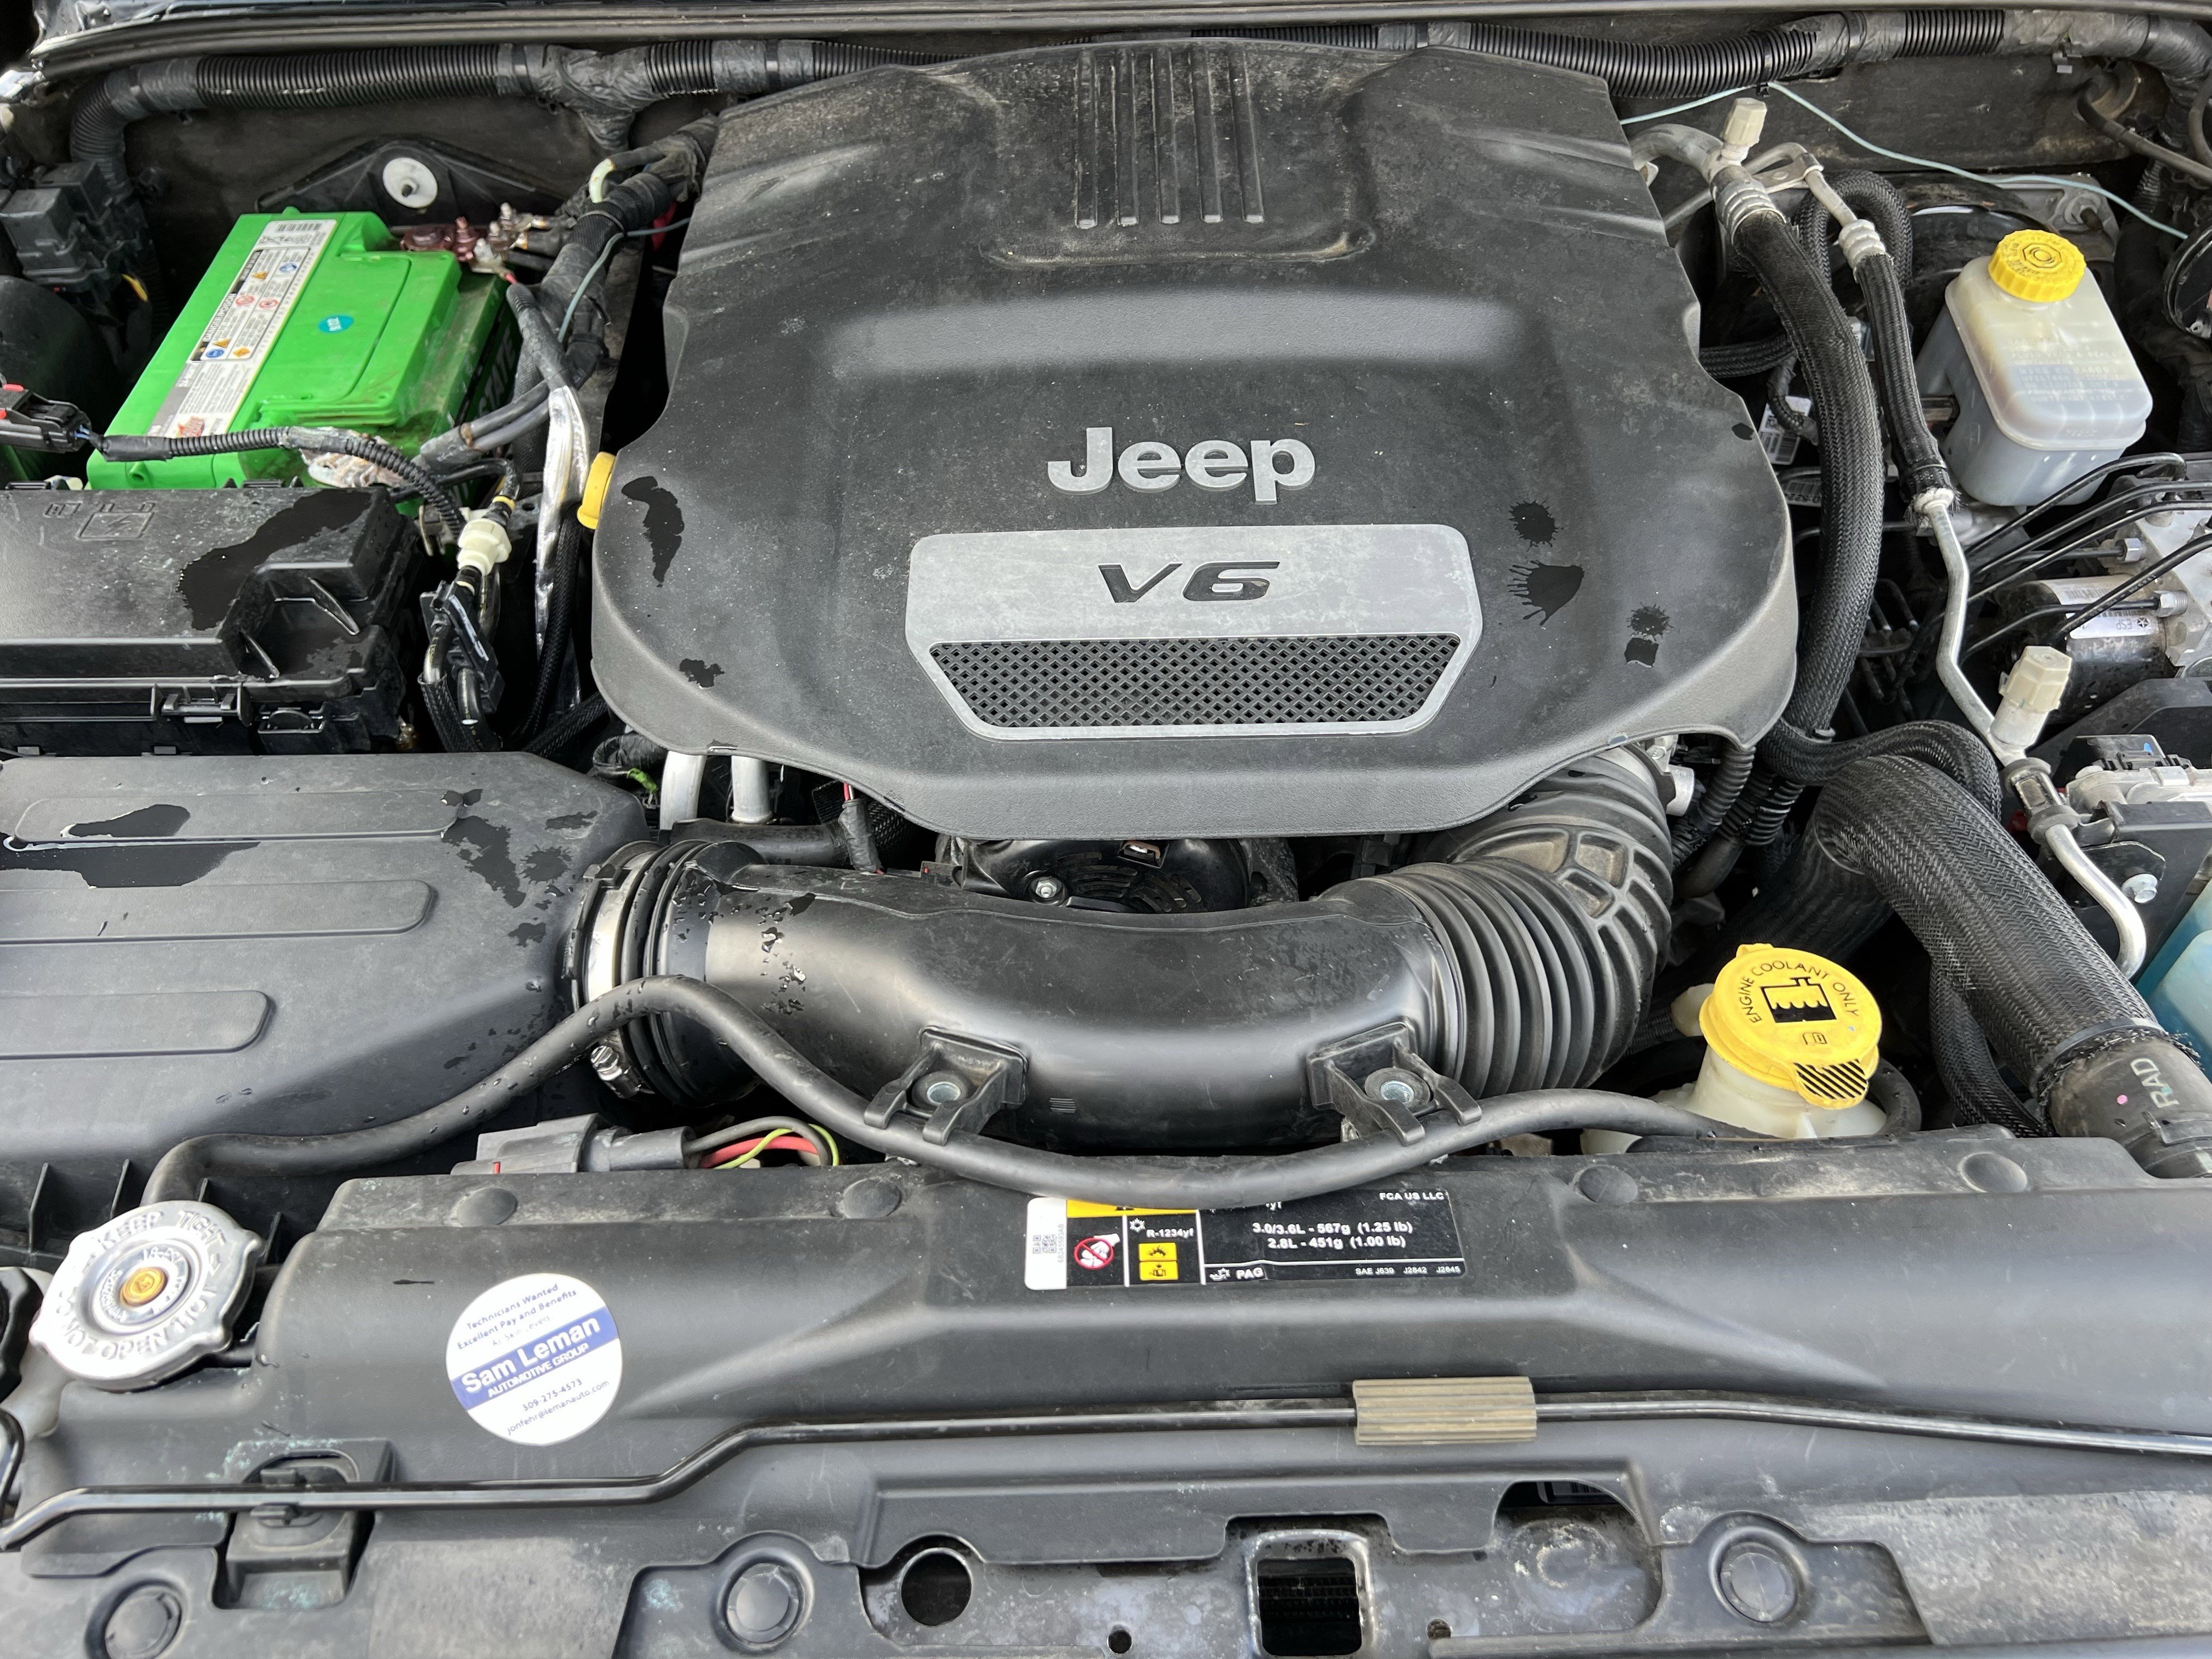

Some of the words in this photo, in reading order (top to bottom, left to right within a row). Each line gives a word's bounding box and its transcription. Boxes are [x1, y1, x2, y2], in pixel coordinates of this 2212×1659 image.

[1047, 426, 1316, 505] Jeep
[1098, 561, 1280, 603] V6
[1737, 976, 1762, 1023] ENGINE
[1751, 960, 1830, 979] COOLANT
[1833, 982, 1859, 1017] ONLY
[2130, 1058, 2180, 1108] RAD
[1379, 1192, 1403, 1200] FCA
[1404, 1192, 1421, 1200] US
[1422, 1192, 1445, 1200] LLC
[96, 1210, 165, 1250] KEEP
[176, 1210, 228, 1246] TIGHT
[1146, 1228, 1194, 1239] R-1234yf
[1252, 1222, 1306, 1235] 3.0/3.6L
[1317, 1222, 1351, 1235] 567g
[1357, 1221, 1392, 1235] (1.25
[1393, 1221, 1413, 1234] lb)
[1267, 1238, 1299, 1249] 2.8L
[1309, 1237, 1344, 1250] 451g
[1350, 1235, 1385, 1249] (1.00
[1386, 1235, 1406, 1249] lb)
[1235, 1267, 1263, 1280] PAG
[1375, 1267, 1396, 1276] J639
[457, 1325, 499, 1350] Excellent
[500, 1317, 517, 1329] Pay
[519, 1306, 537, 1320] and
[538, 1289, 577, 1311] Benefits
[466, 1301, 521, 1330] Technicians
[522, 1284, 558, 1305] Wanted
[461, 1358, 517, 1393] Sam
[517, 1317, 601, 1367] Leman
[487, 1361, 553, 1398] AUTOMOTIVE
[551, 1342, 589, 1367] GROUP
[522, 1378, 583, 1412] 309-275-4573
